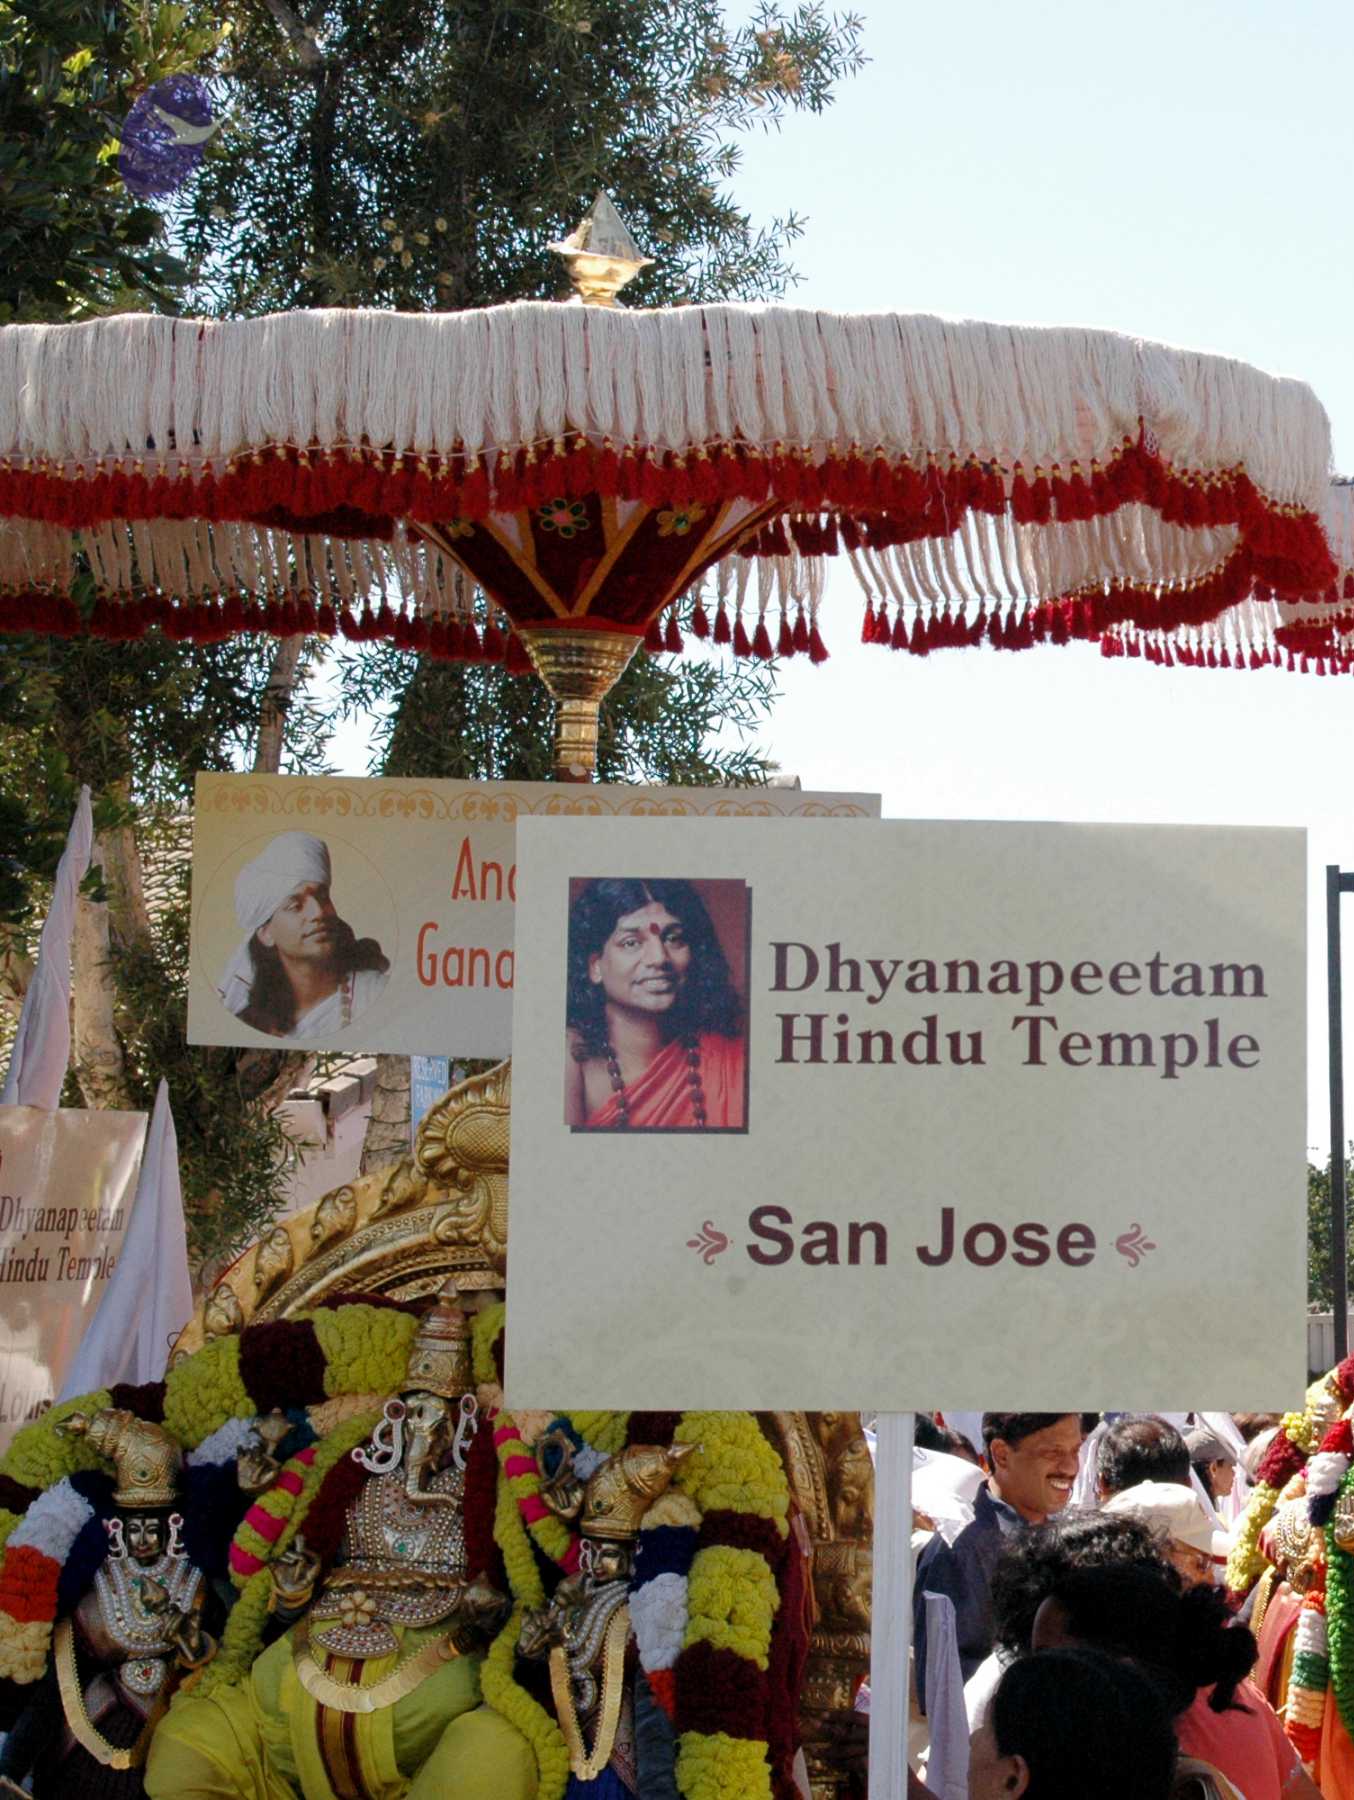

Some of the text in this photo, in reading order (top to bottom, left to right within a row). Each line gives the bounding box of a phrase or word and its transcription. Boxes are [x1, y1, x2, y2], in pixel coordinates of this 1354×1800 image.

[769, 942, 1268, 1006] Dhyanapeetam
[775, 1013, 1261, 1079] Hindu Temple
[747, 1205, 1097, 1267] San Jose
